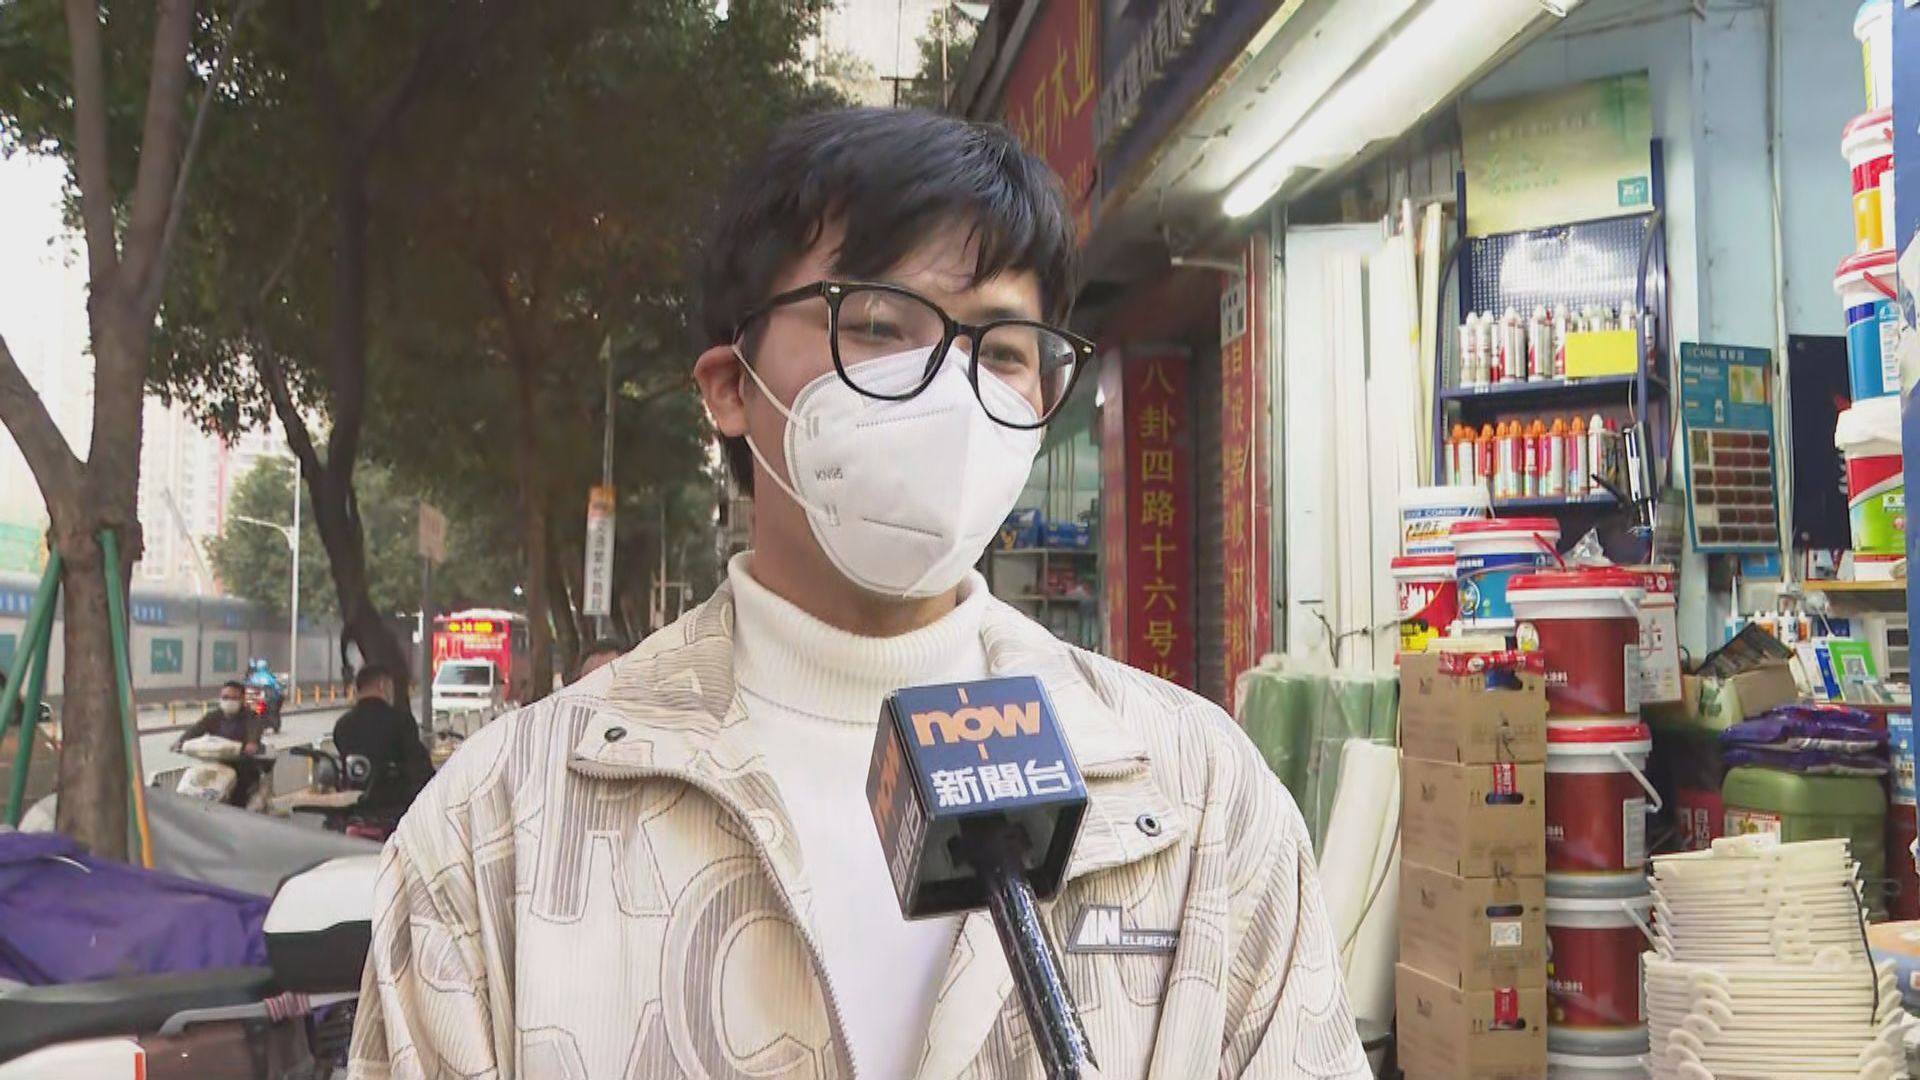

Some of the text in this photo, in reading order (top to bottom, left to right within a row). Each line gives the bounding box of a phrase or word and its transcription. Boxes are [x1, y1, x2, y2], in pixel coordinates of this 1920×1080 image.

[815, 467, 843, 481] KN95
[911, 701, 1042, 747] now
[930, 759, 1072, 807] 新聞台
